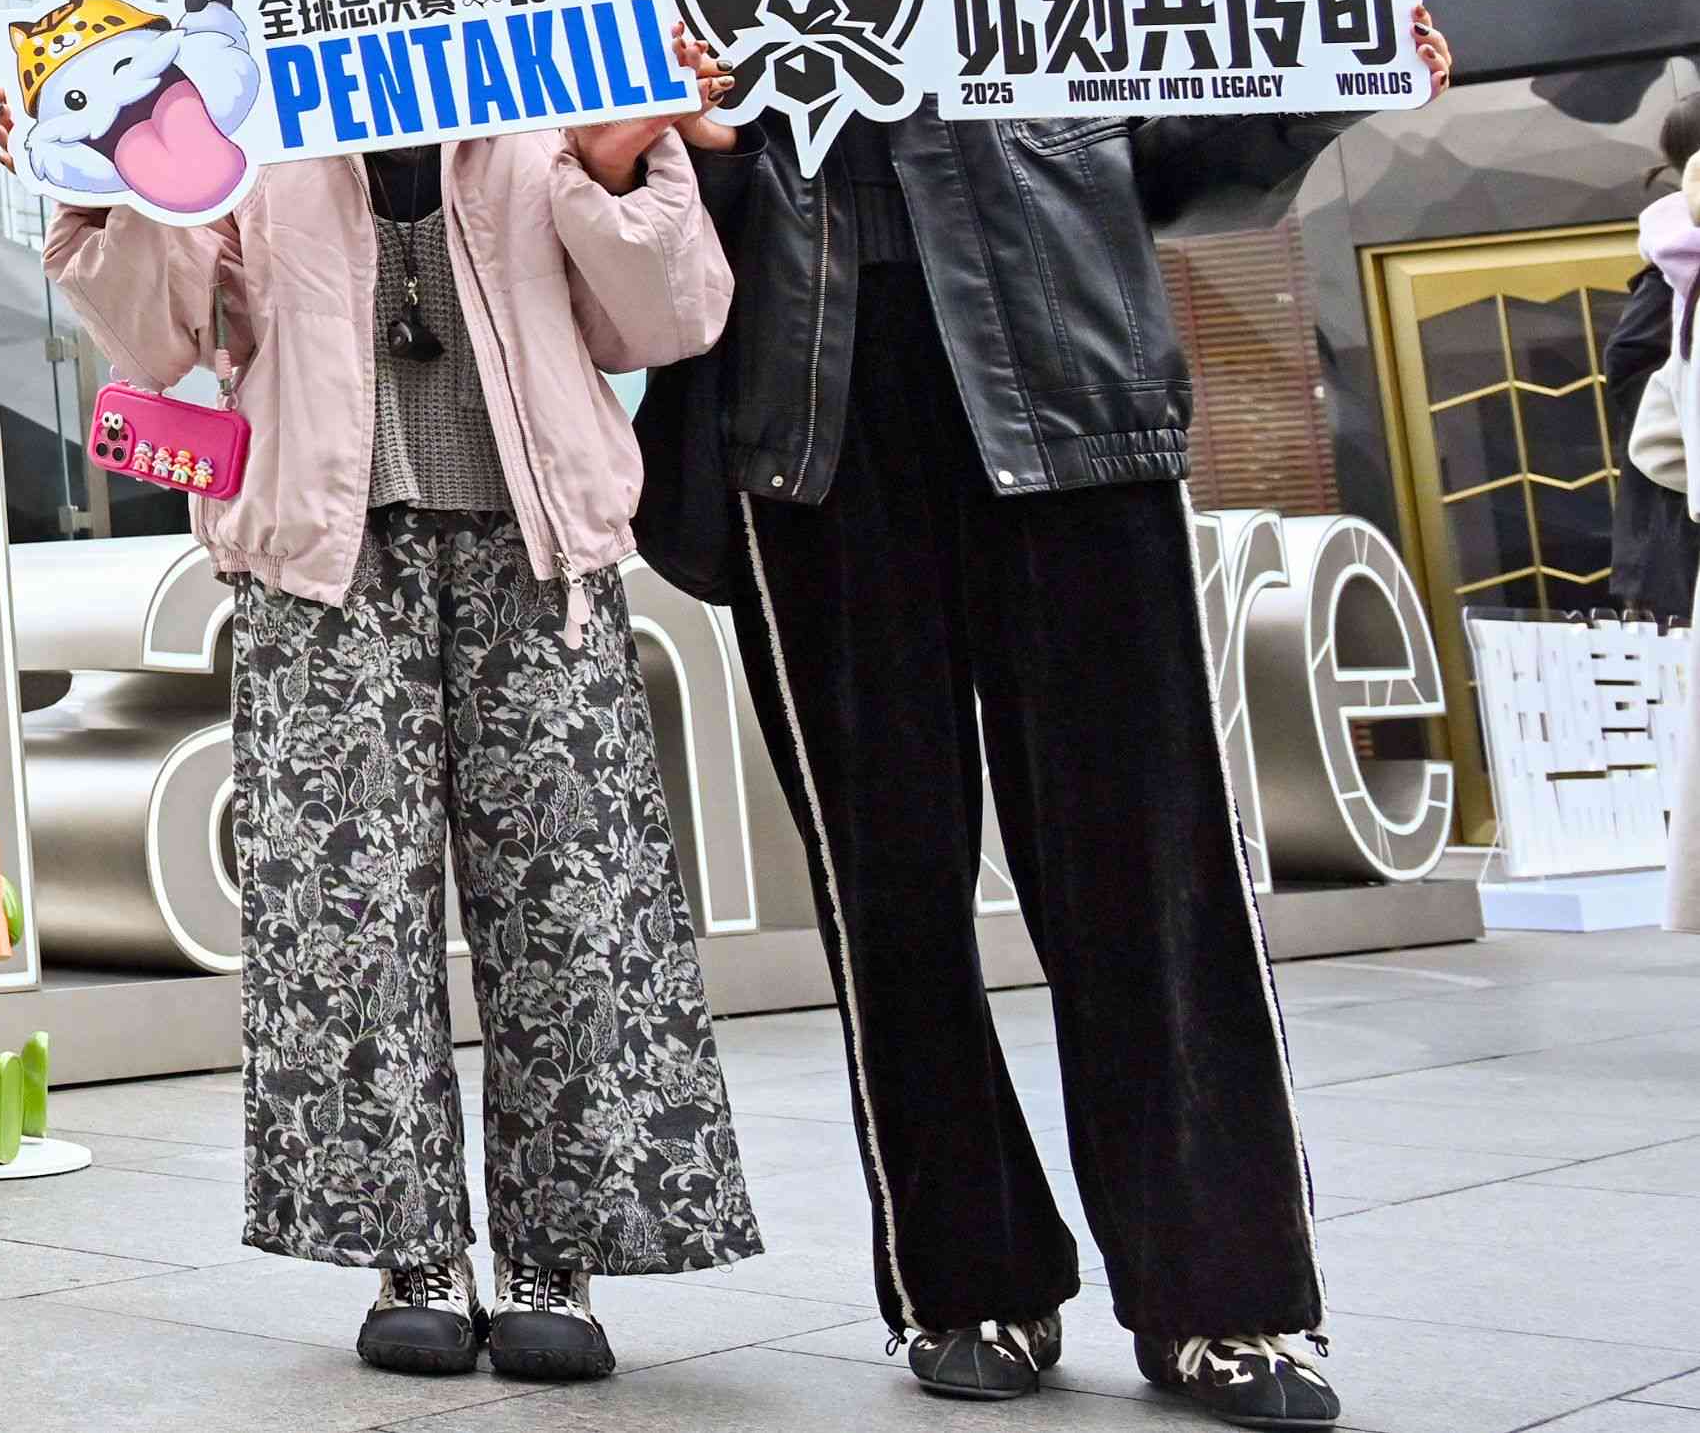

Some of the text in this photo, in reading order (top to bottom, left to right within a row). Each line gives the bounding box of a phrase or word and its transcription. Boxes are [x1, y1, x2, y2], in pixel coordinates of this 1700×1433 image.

[960, 71, 1413, 105] 2025 MOMENT INTO LEGACY WORLDS
